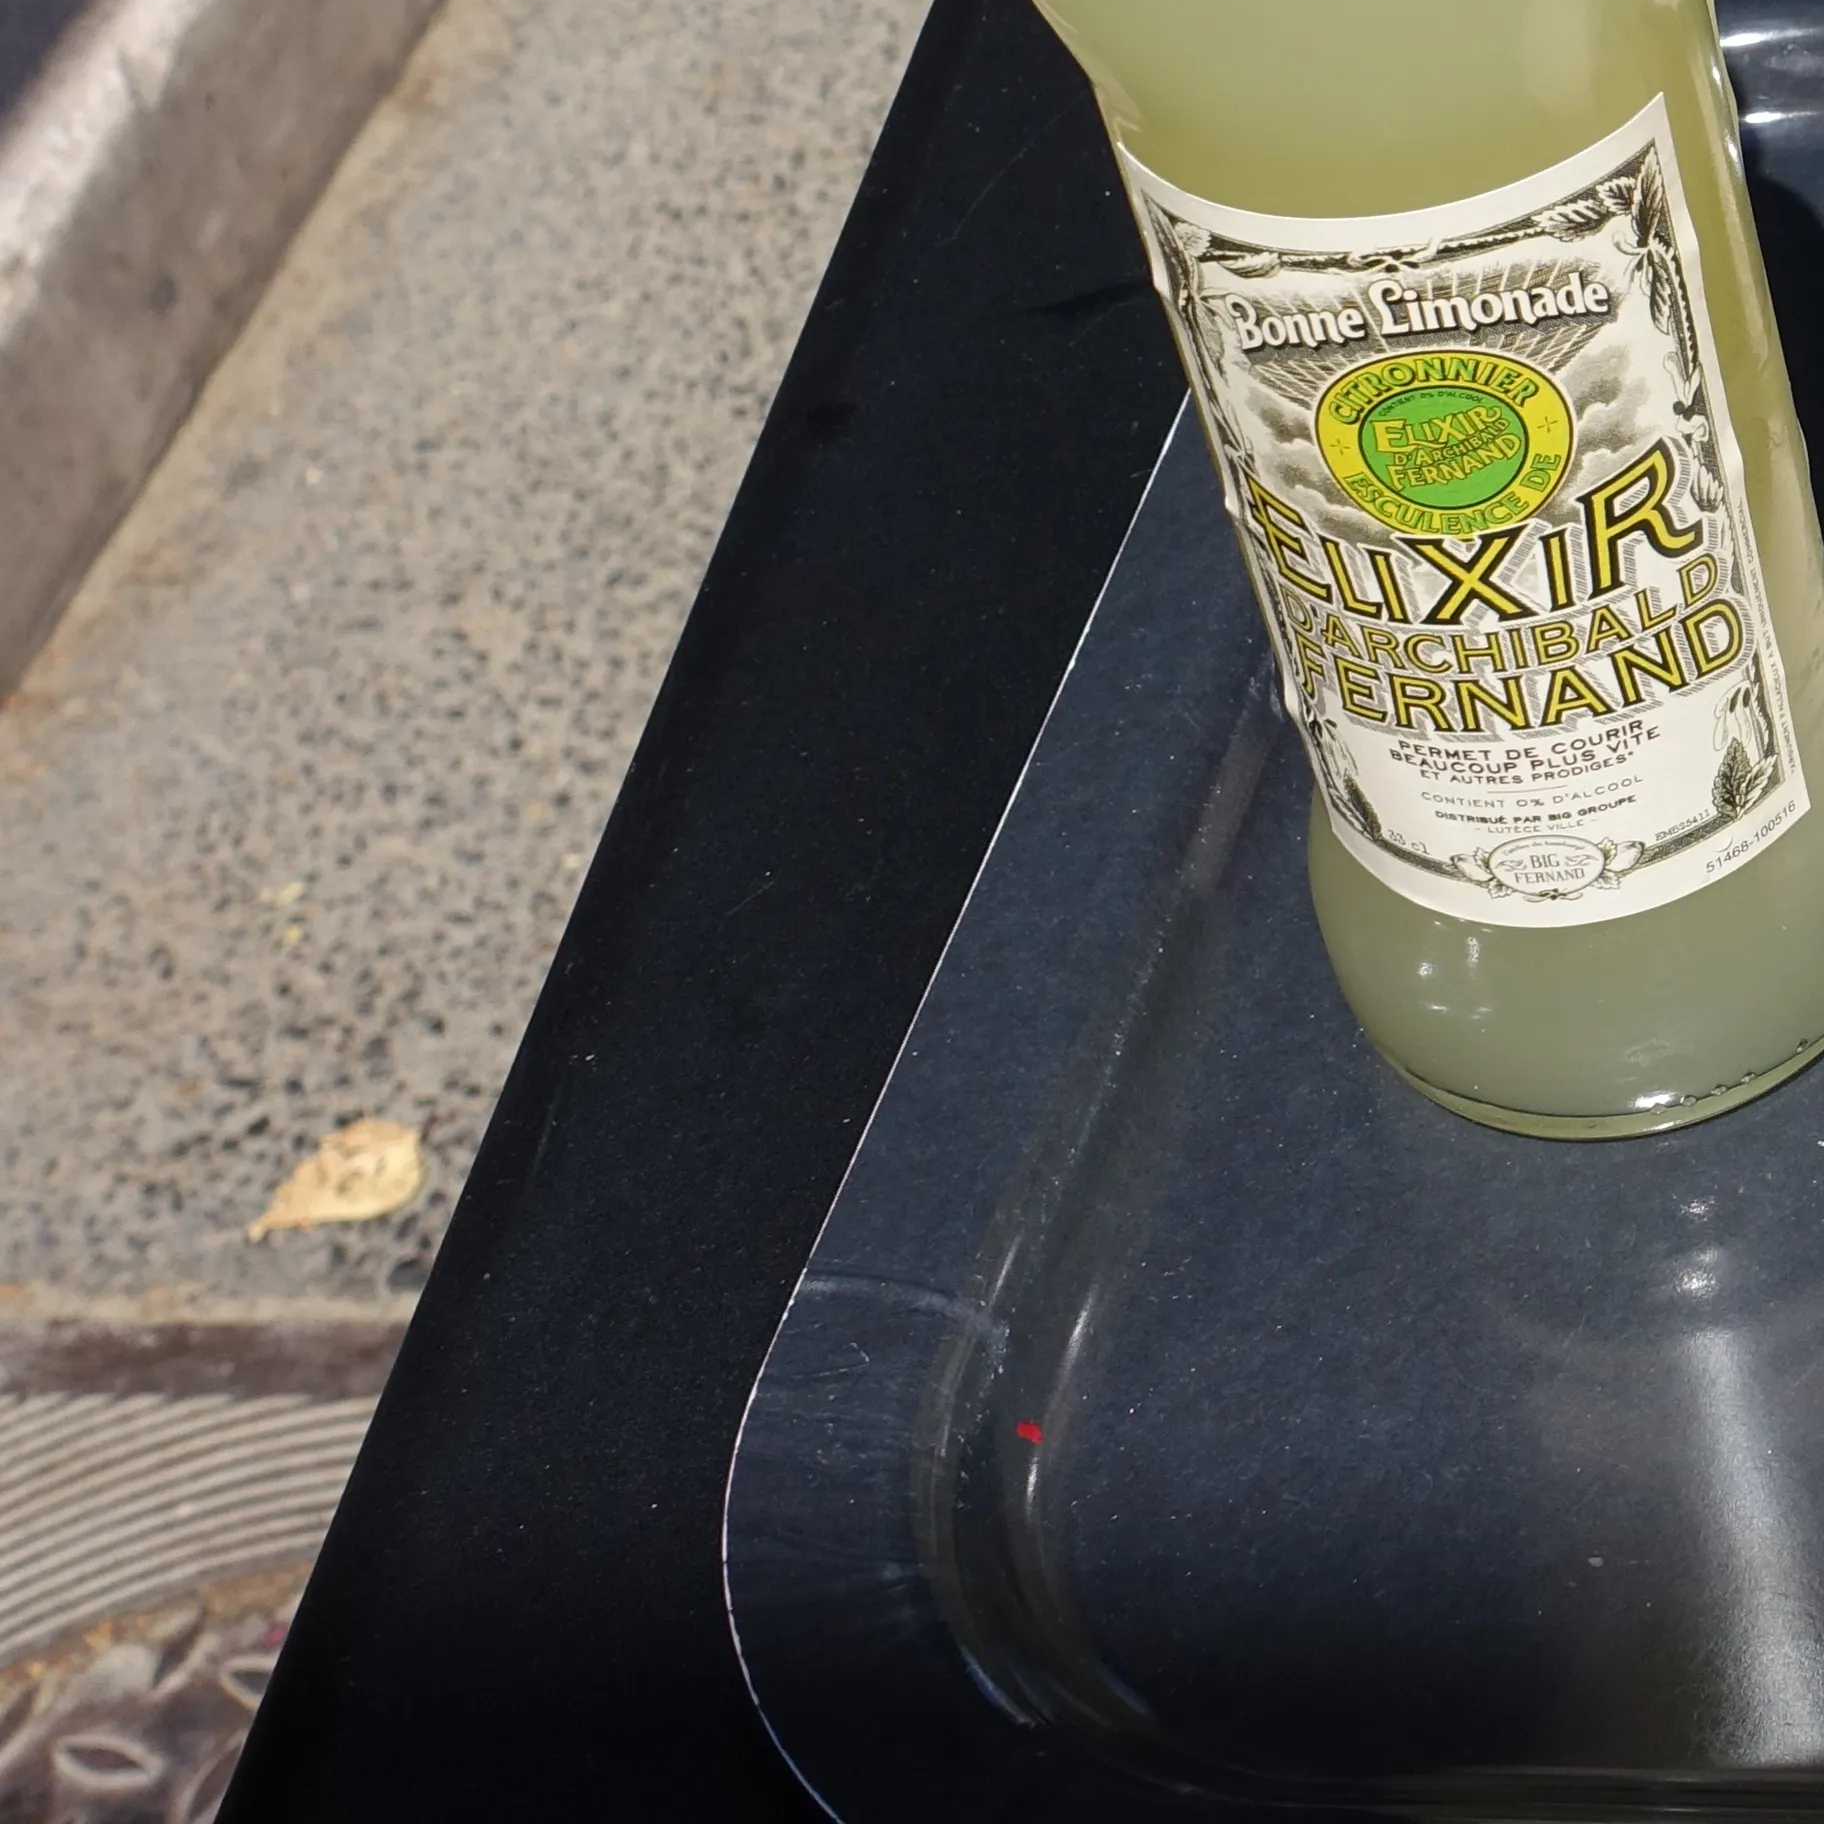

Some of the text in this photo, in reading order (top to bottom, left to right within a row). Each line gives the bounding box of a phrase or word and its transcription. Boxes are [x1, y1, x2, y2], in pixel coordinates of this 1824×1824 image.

[1226, 272, 1611, 351] Bonne Limonade
[1329, 357, 1540, 425] CITRONNIER
[1371, 405, 1502, 453] ELIXIR
[1394, 416, 1511, 467] D'ARCHIBALD
[1386, 433, 1522, 492] FERNAND
[1344, 453, 1562, 535] ESCULENCE DE
[1246, 438, 1700, 628] ELIXIR
[1281, 552, 1720, 677] D'ARCHIBALD
[1292, 596, 1746, 735] FERNAND
[1389, 726, 1661, 775] BEAUCOUP PLUS VITE
[1398, 719, 1644, 762] PERMET DE COURIR
[1420, 769, 1440, 780] ET
[1449, 773, 1524, 785] AUTRES
[1421, 774, 1643, 808] CONTIENT 0% D'ALCOOL
[1434, 794, 1638, 825] DISTRIBUÉ PAR BIG GROUPE
[1546, 817, 1586, 832] VILLE
[1387, 828, 1431, 856] 33 cl
[1530, 852, 1561, 870] BIG
[1514, 867, 1586, 885] FERNAND
